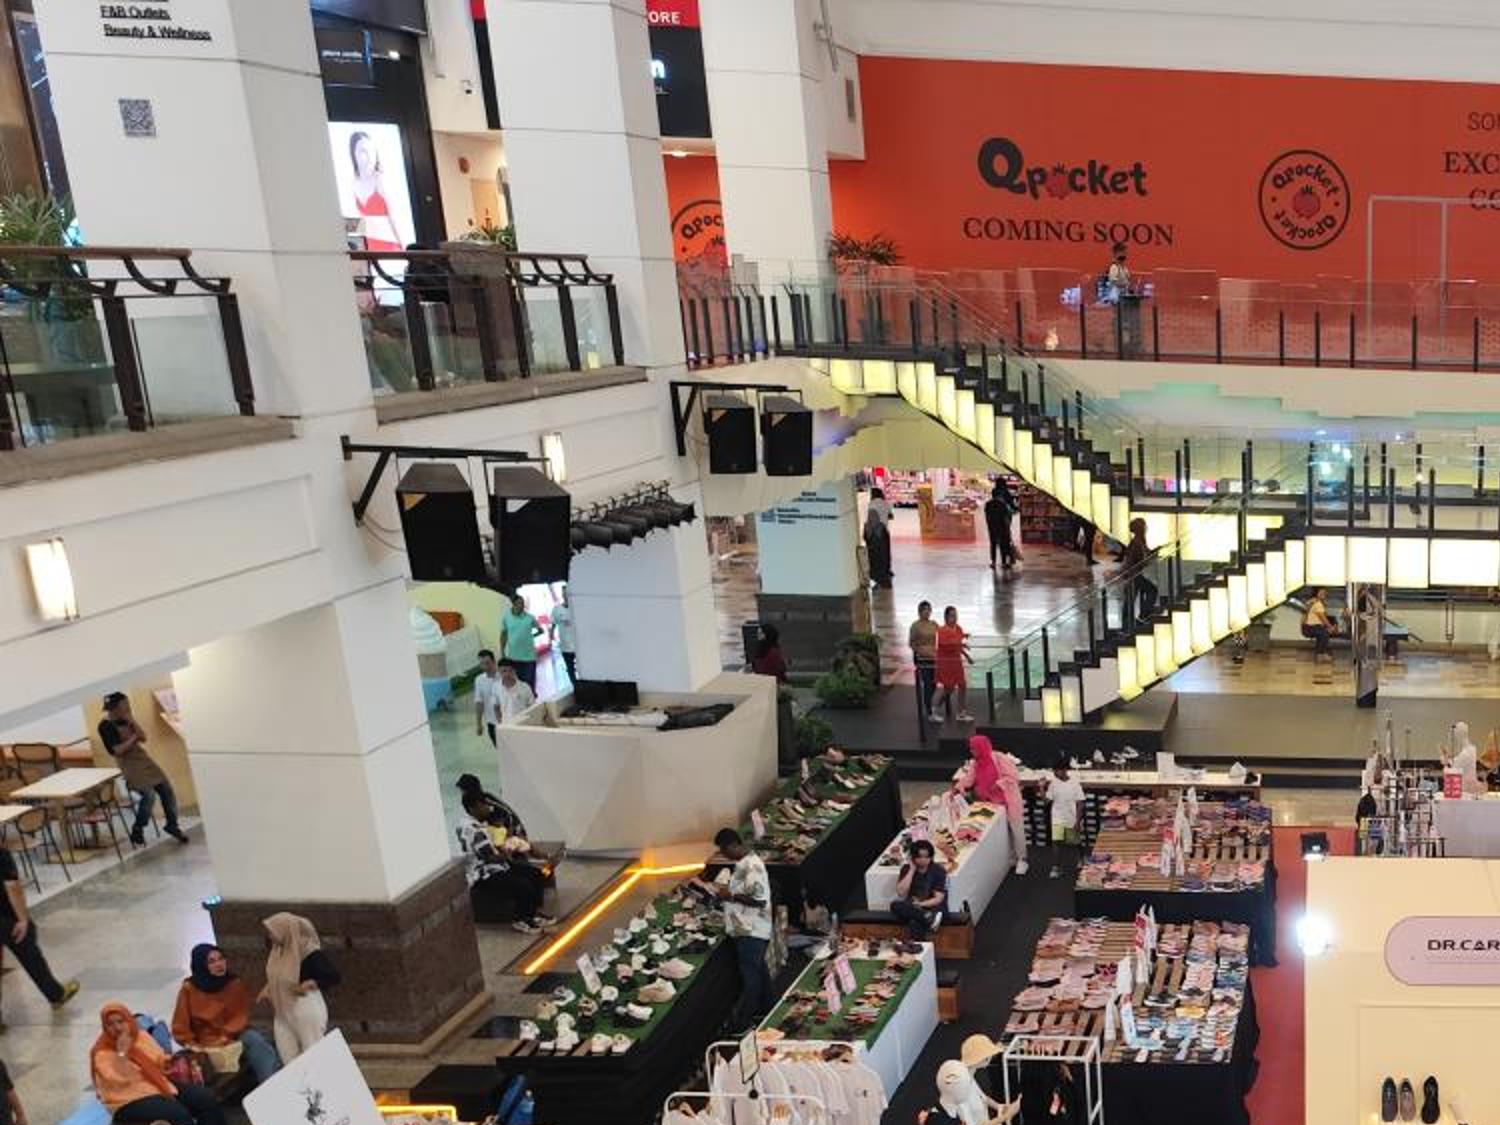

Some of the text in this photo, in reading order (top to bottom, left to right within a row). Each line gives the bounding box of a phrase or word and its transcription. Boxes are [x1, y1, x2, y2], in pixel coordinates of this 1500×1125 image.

[158, 27, 212, 41] Wellness
[963, 217, 1174, 247] COMING SOON
